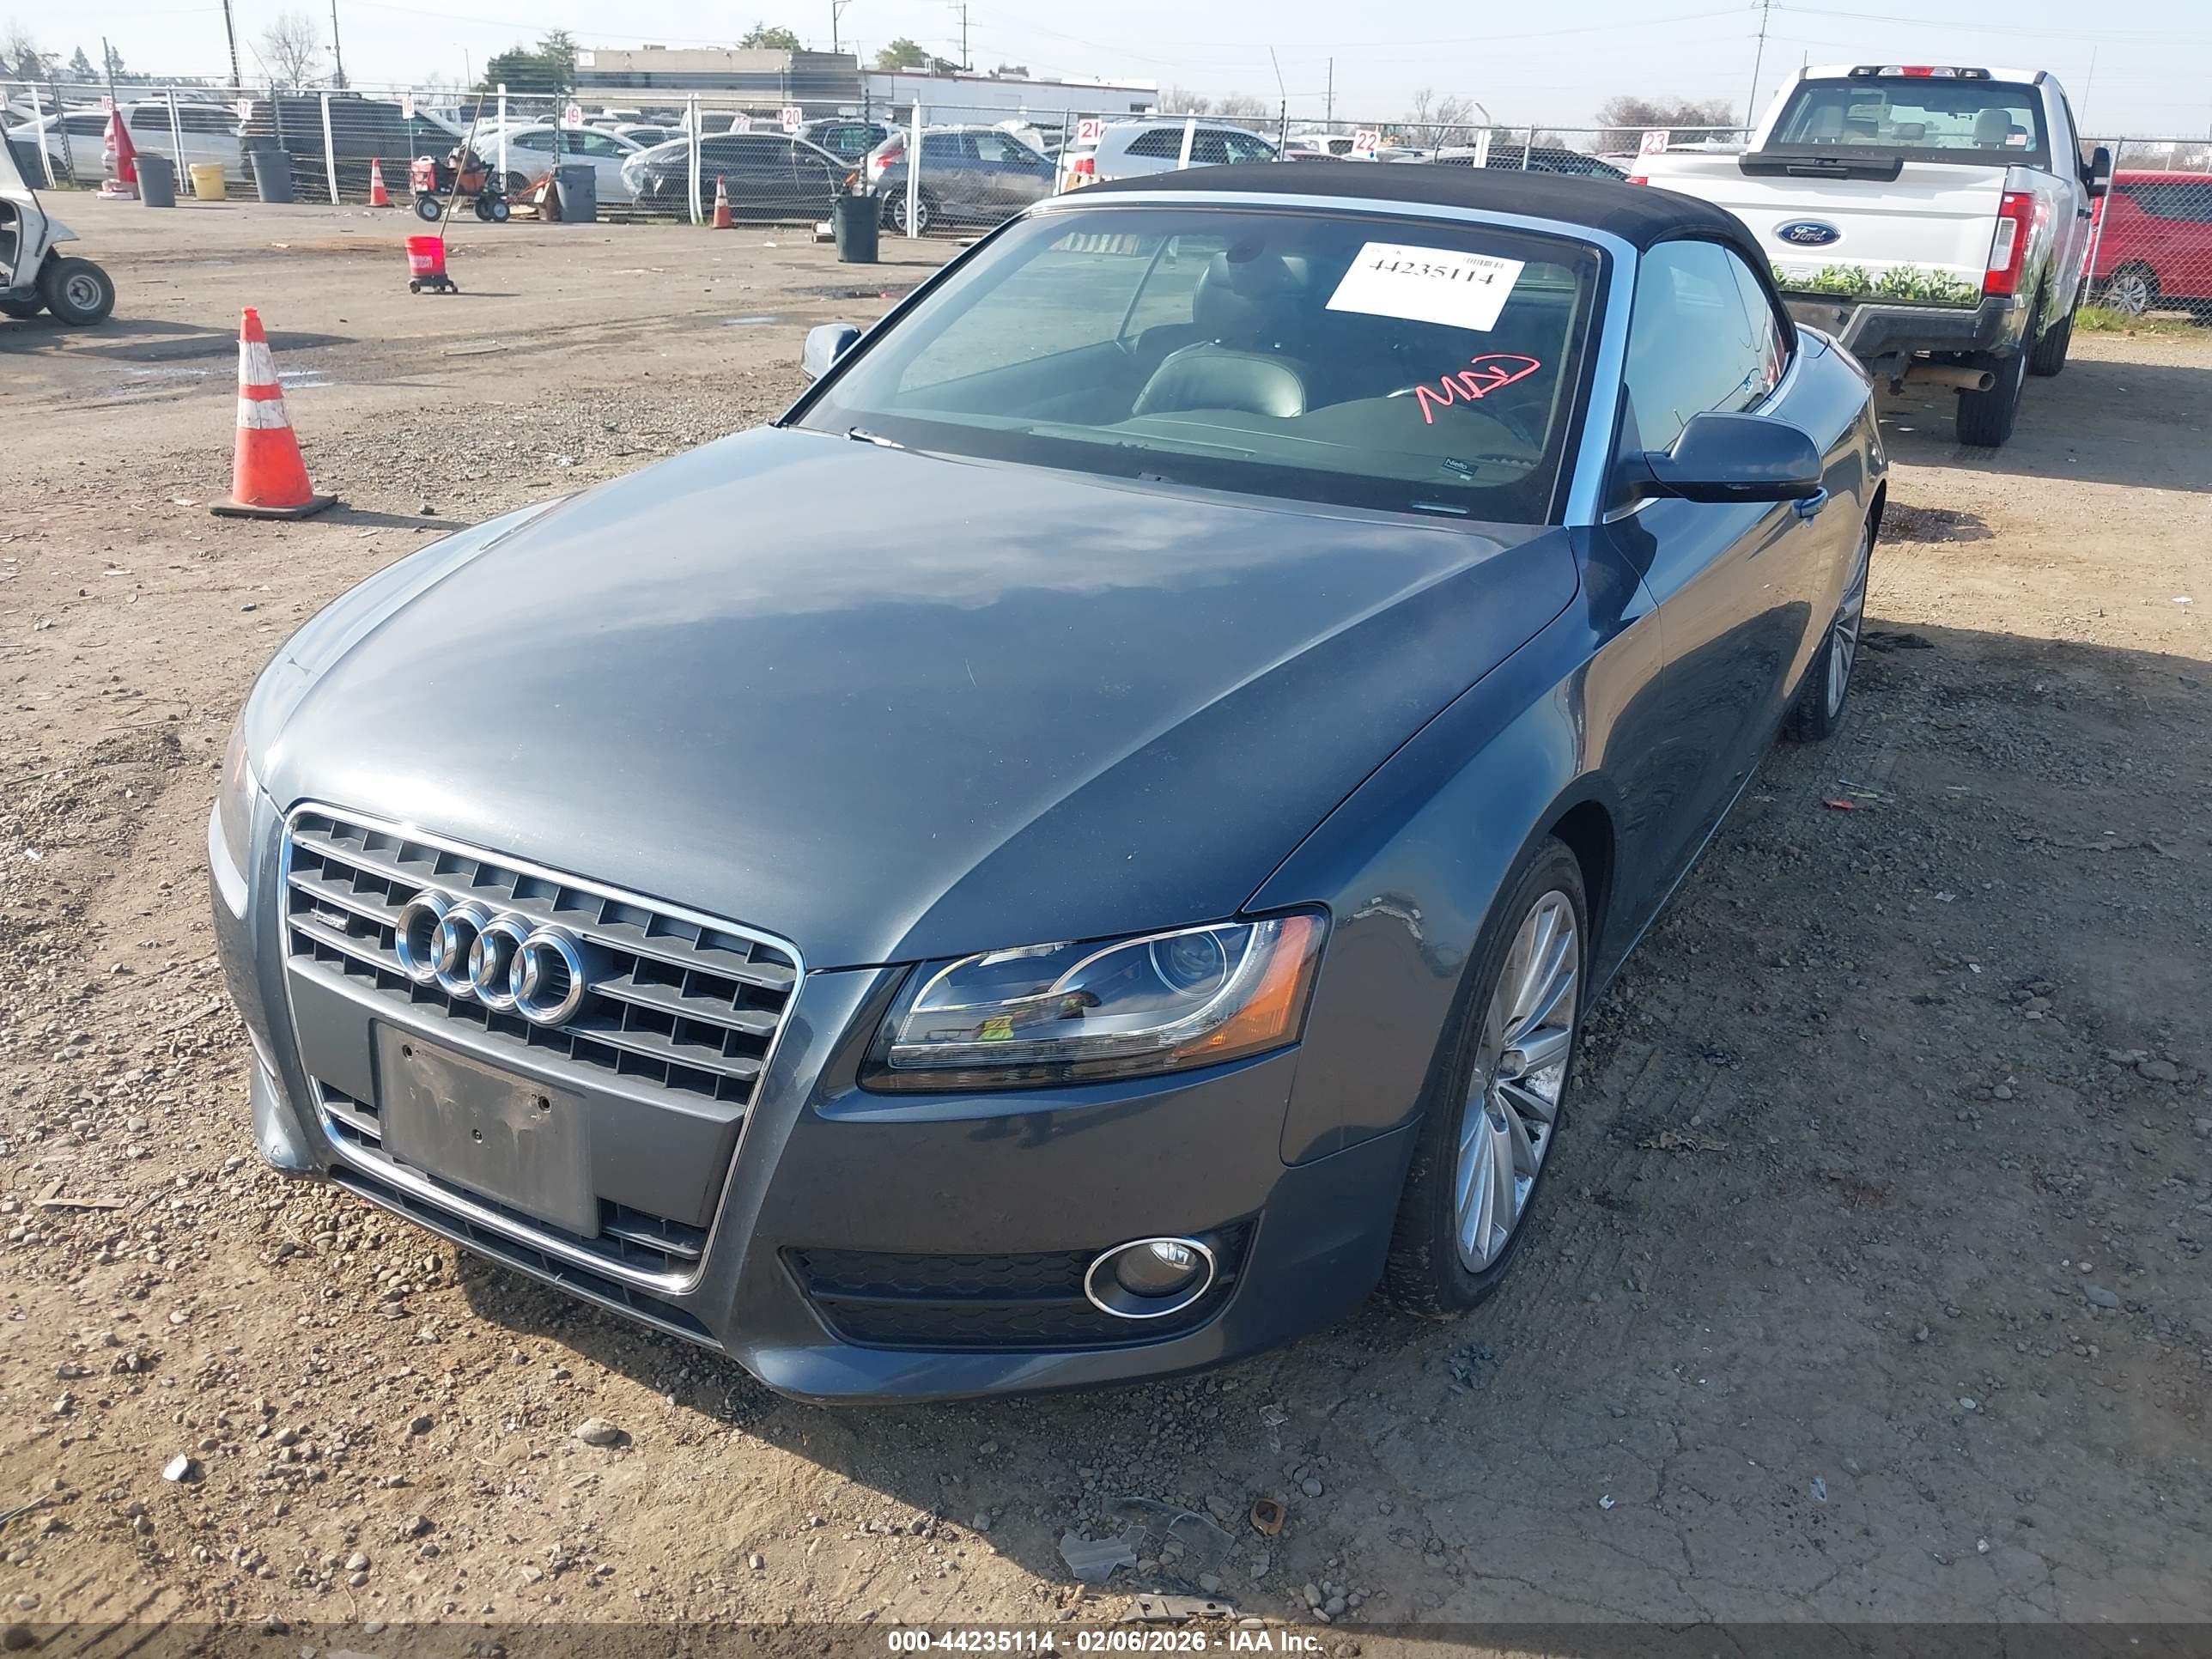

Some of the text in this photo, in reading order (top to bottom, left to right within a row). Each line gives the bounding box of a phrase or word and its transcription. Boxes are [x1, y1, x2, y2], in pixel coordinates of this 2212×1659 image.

[568, 108, 579, 123] 19
[785, 109, 799, 125] 20
[1082, 121, 1098, 137] 21
[1356, 132, 1377, 151] 22
[1644, 132, 1665, 152] 23
[1790, 224, 1826, 242] Ford
[1369, 258, 1495, 285] 44235114
